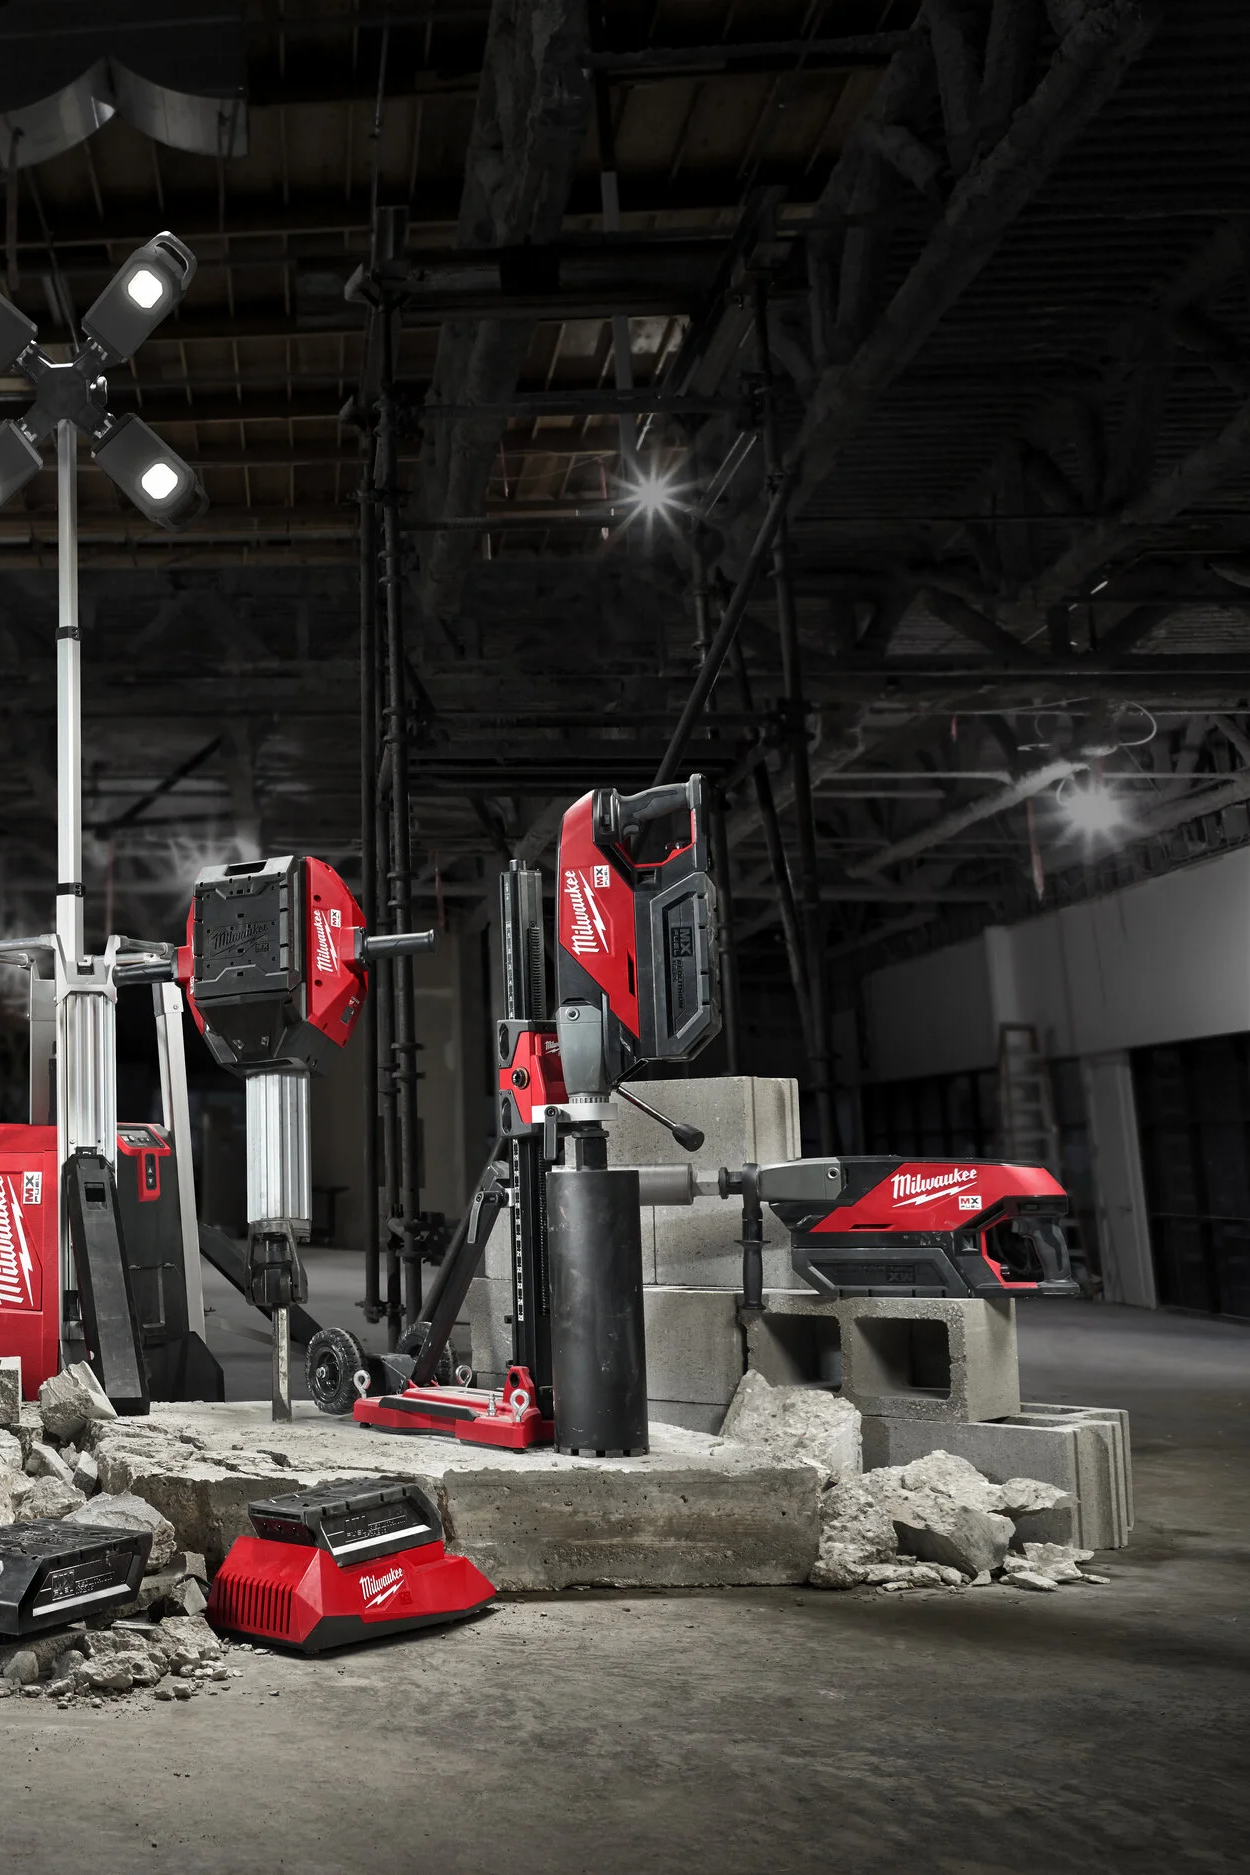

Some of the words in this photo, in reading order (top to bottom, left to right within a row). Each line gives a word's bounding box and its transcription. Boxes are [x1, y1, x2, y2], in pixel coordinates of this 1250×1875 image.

[596, 868, 605, 886] MX
[332, 911, 337, 926] MX
[564, 870, 600, 956] Milwaukee
[211, 924, 269, 950] Milwaukee
[313, 910, 334, 972] Milwaukee
[679, 928, 692, 957] MX
[24, 1174, 35, 1203] MX
[891, 1168, 978, 1199] Milwaukee
[960, 1197, 979, 1205] MX
[359, 1567, 404, 1600] Milwaukee
